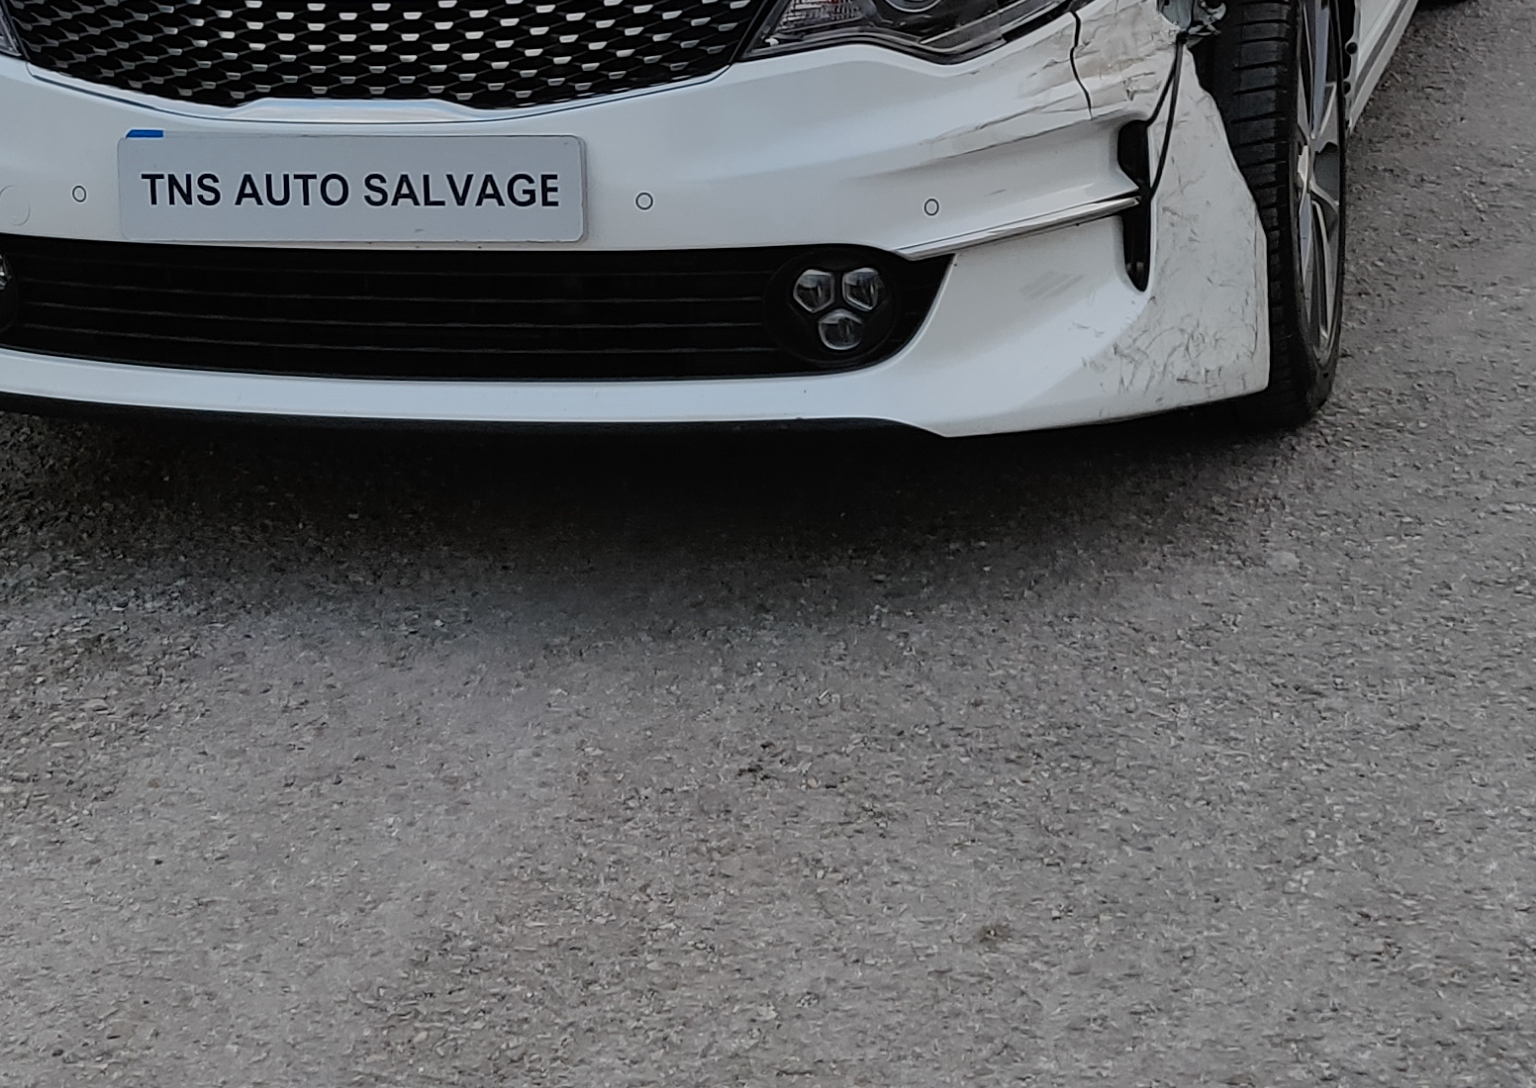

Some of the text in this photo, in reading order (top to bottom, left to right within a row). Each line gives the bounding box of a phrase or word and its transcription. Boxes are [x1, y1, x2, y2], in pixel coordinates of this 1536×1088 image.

[140, 173, 561, 208] TNS AUTO SALVAGE
